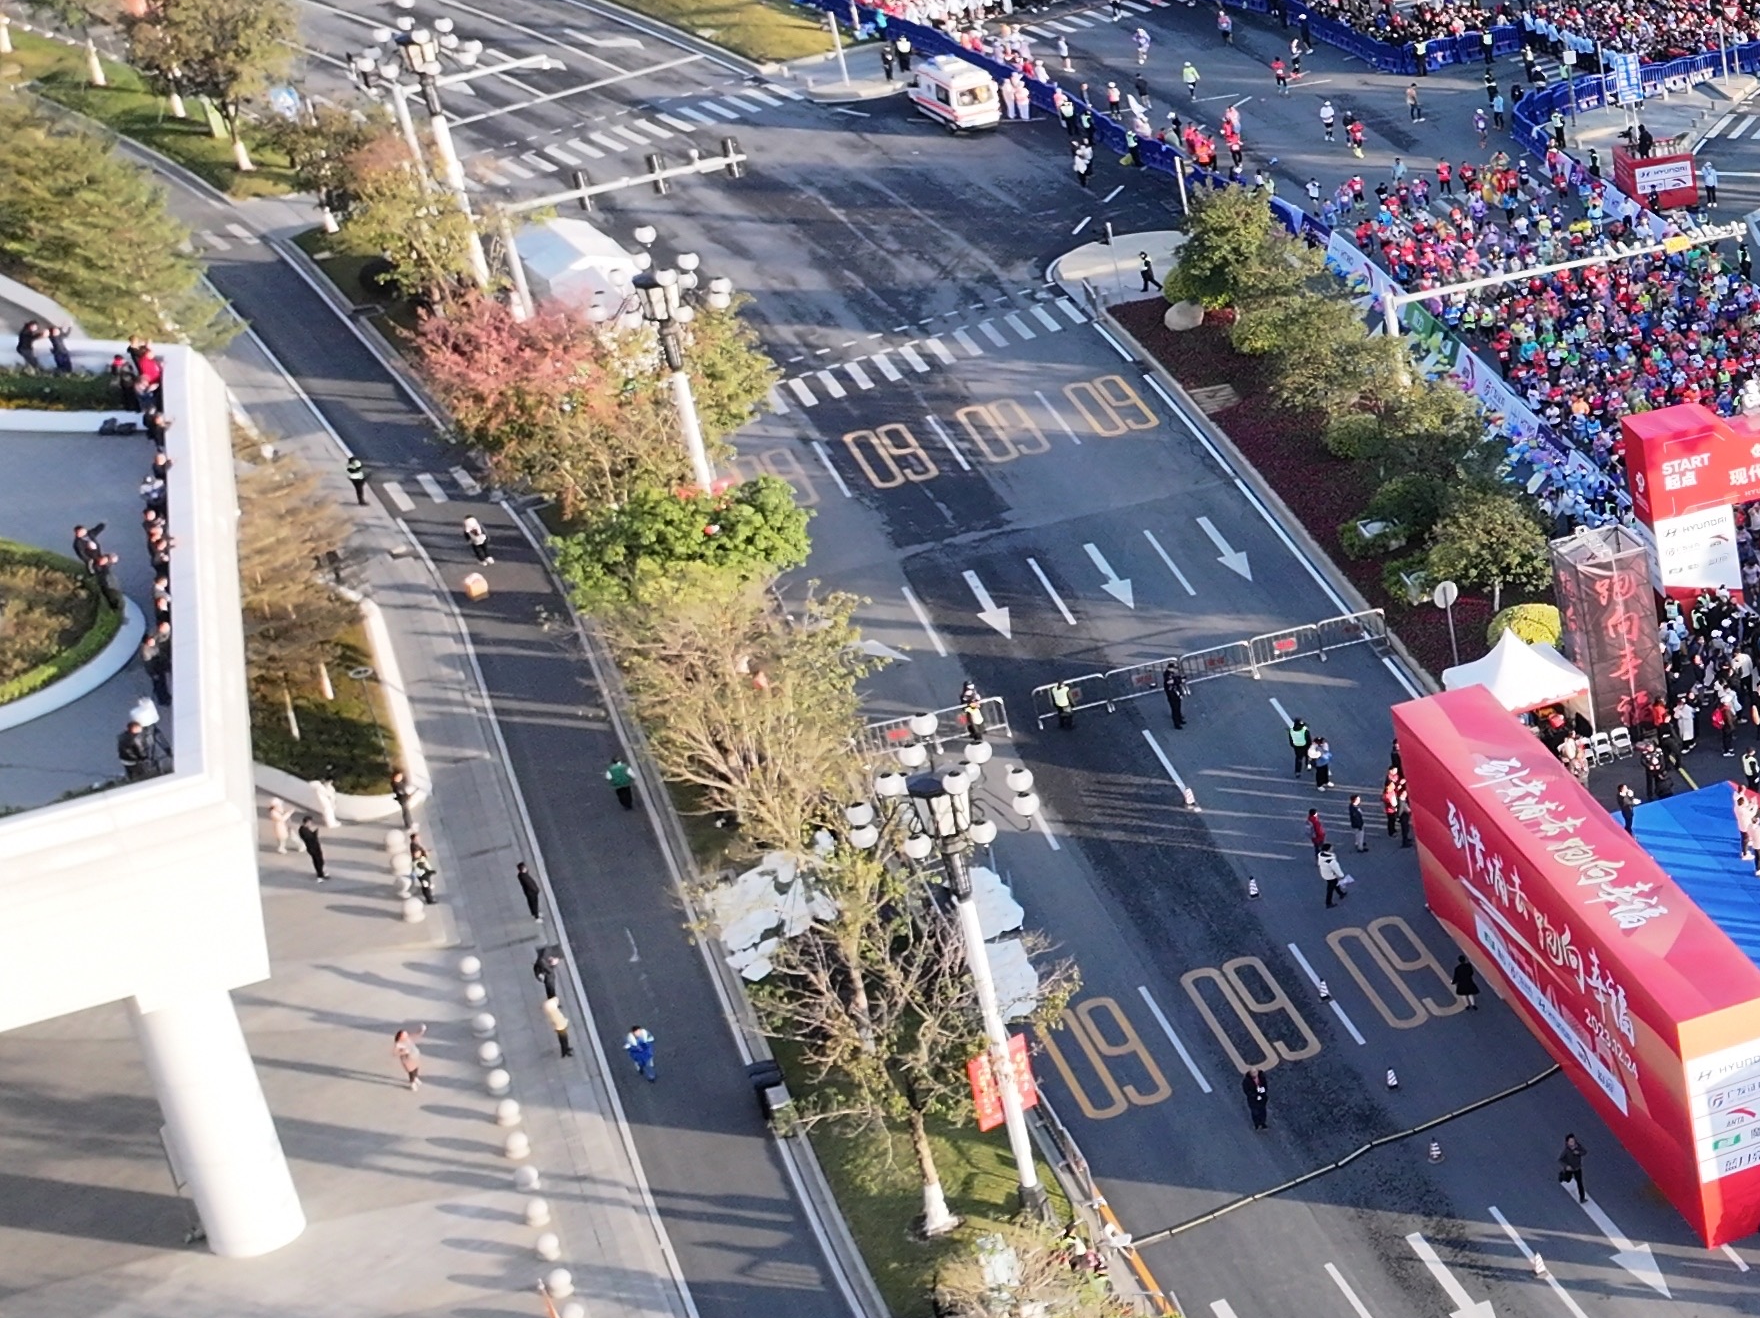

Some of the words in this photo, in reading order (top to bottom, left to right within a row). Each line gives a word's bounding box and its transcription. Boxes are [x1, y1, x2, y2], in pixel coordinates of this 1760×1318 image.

[1662, 453, 1711, 476] START
[1664, 471, 1698, 491] 起点
[1682, 516, 1727, 534] HYUNDAI
[1468, 755, 1669, 930] 到黄埔去跑向幸福
[1446, 798, 1635, 1048] 到黄埔去跑向幸福
[1584, 1007, 1639, 1079] 2023.12.24
